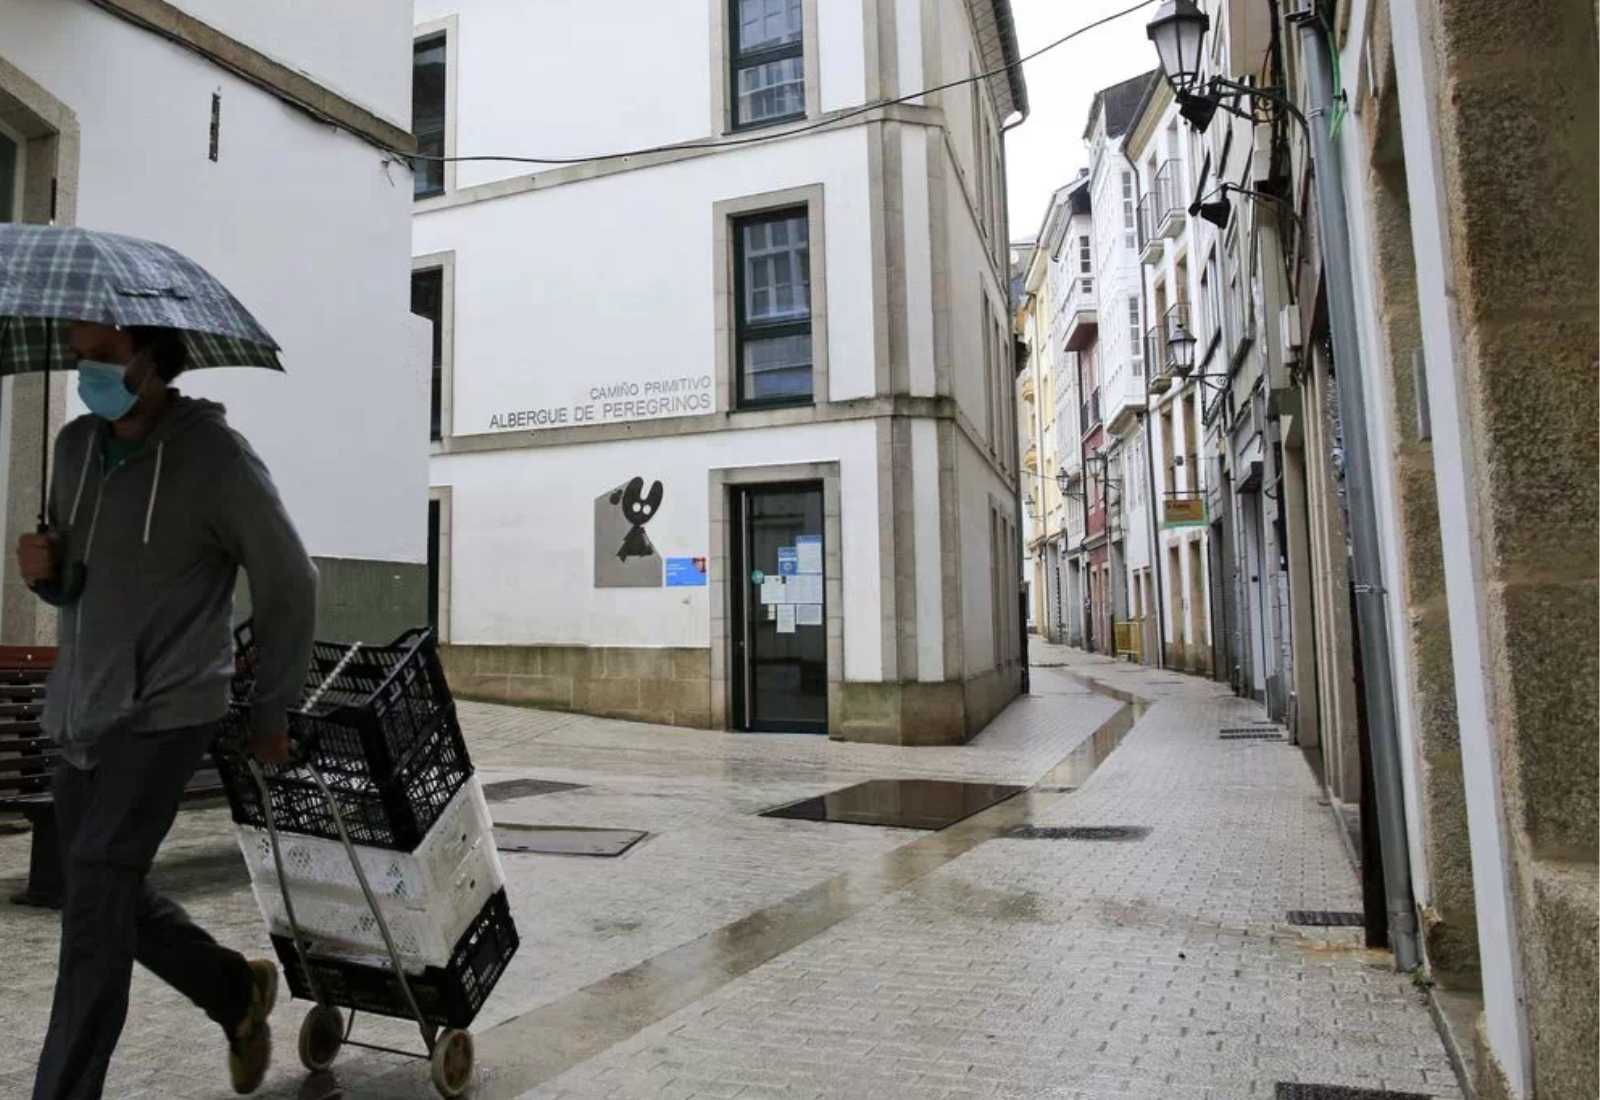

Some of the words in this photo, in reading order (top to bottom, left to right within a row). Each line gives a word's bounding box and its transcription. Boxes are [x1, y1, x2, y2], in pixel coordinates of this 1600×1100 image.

[590, 382, 639, 400] CAMIÑO
[644, 375, 712, 395] PRIMITIVO
[489, 407, 568, 429] ALBERGUE
[574, 404, 594, 422] DE
[602, 393, 711, 419] PEREGRINOS
